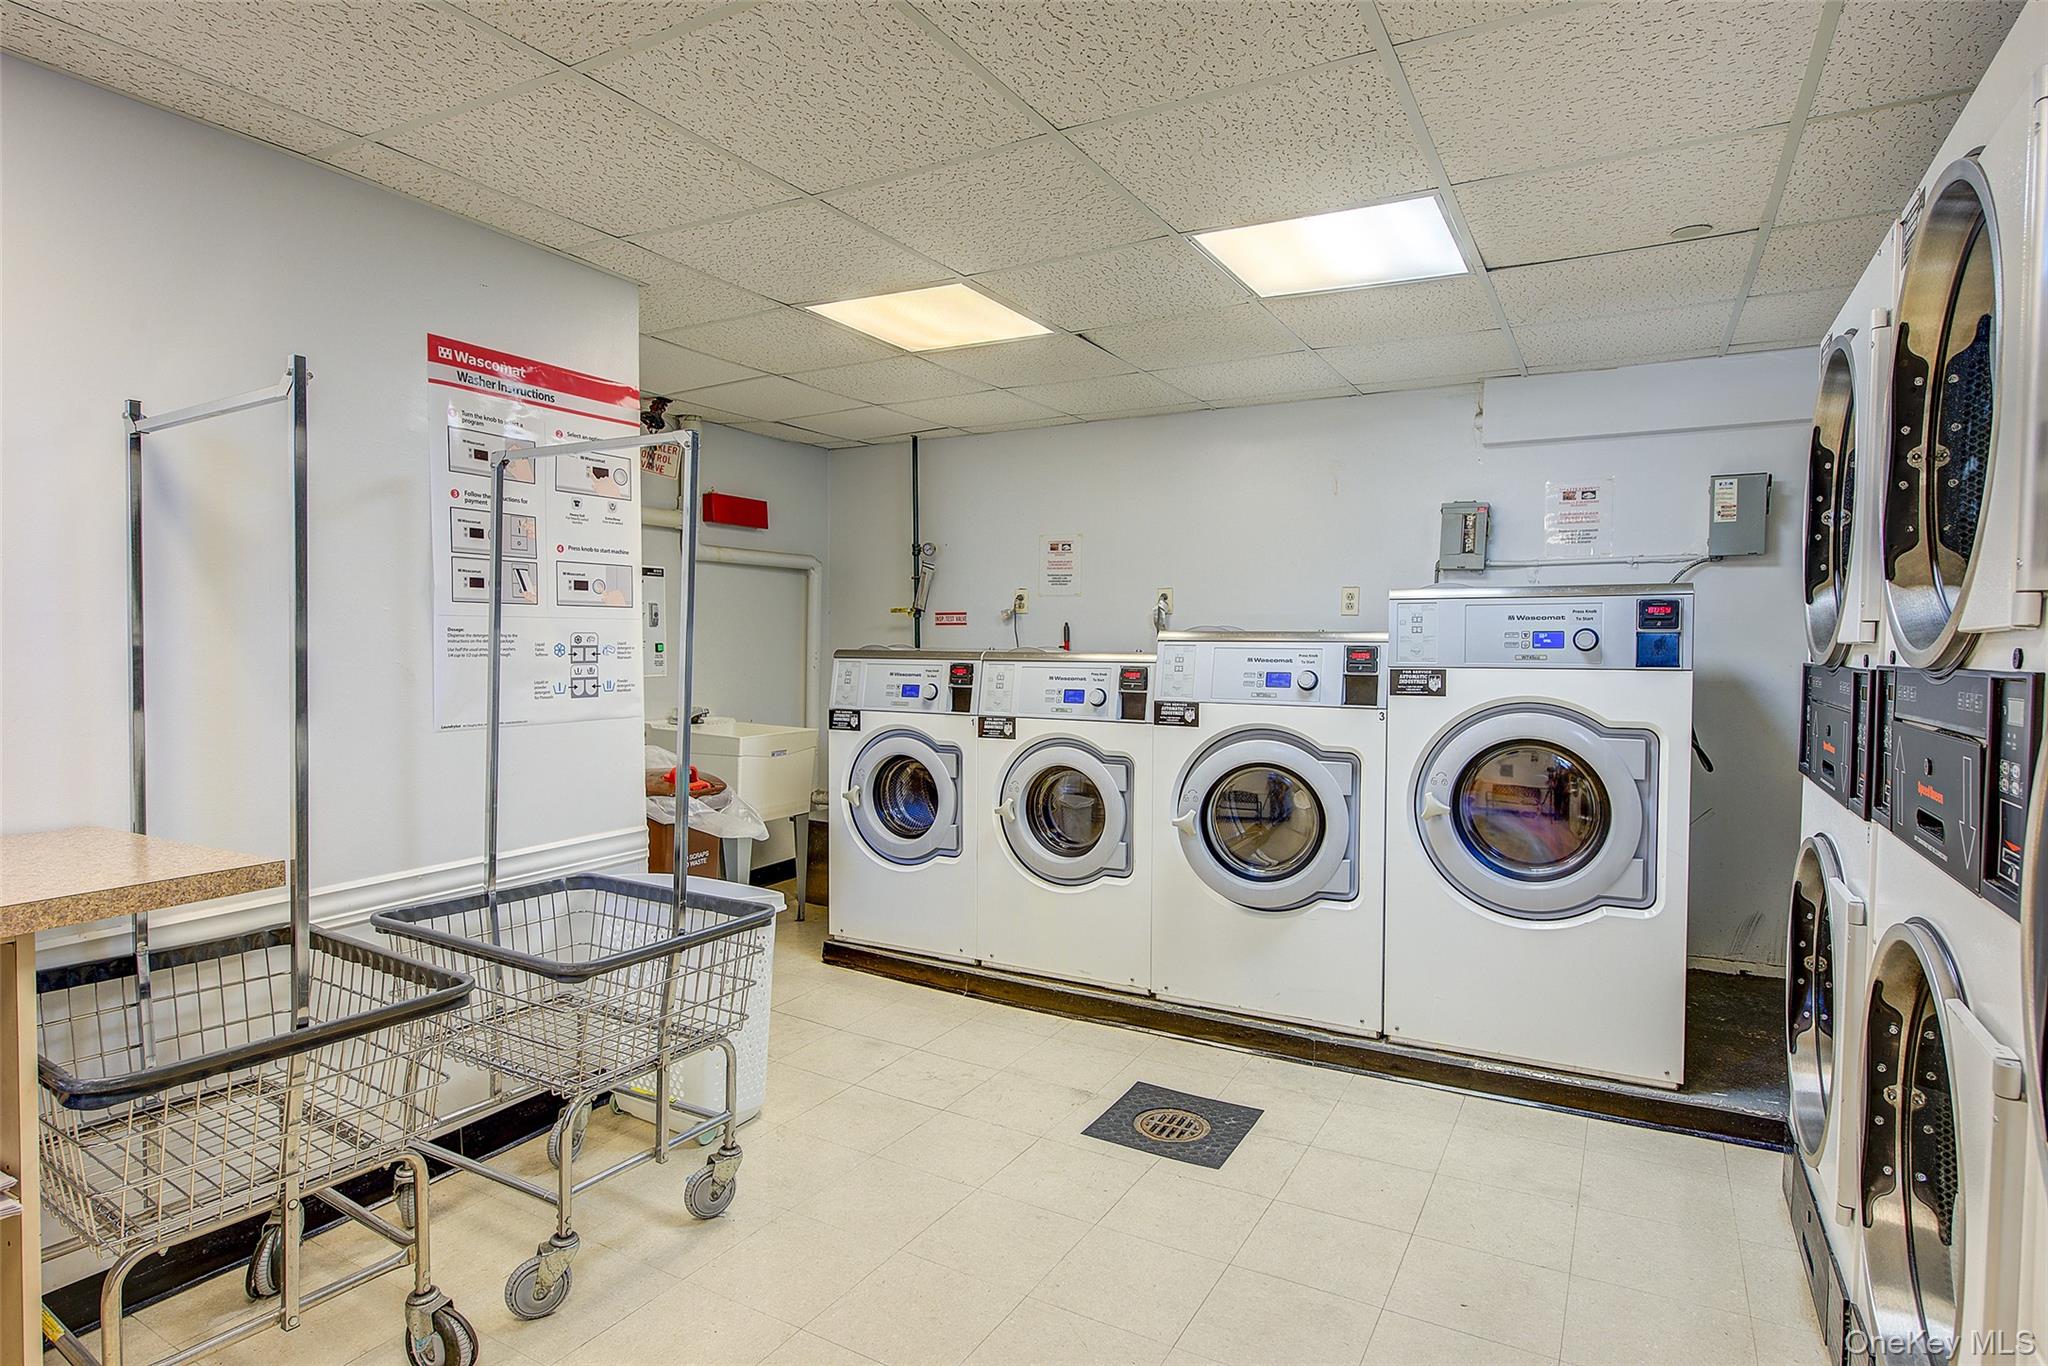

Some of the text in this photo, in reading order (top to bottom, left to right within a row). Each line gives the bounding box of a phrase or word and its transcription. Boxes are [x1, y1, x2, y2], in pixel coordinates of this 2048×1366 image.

[454, 349, 526, 378] Wascomat
[456, 370, 496, 389] Washer
[462, 418, 484, 427] program
[483, 415, 497, 423] knob
[464, 490, 481, 498] Follow
[1379, 711, 1386, 721] 3
[689, 850, 710, 860] SCRAPS
[690, 858, 707, 867] WASTE
